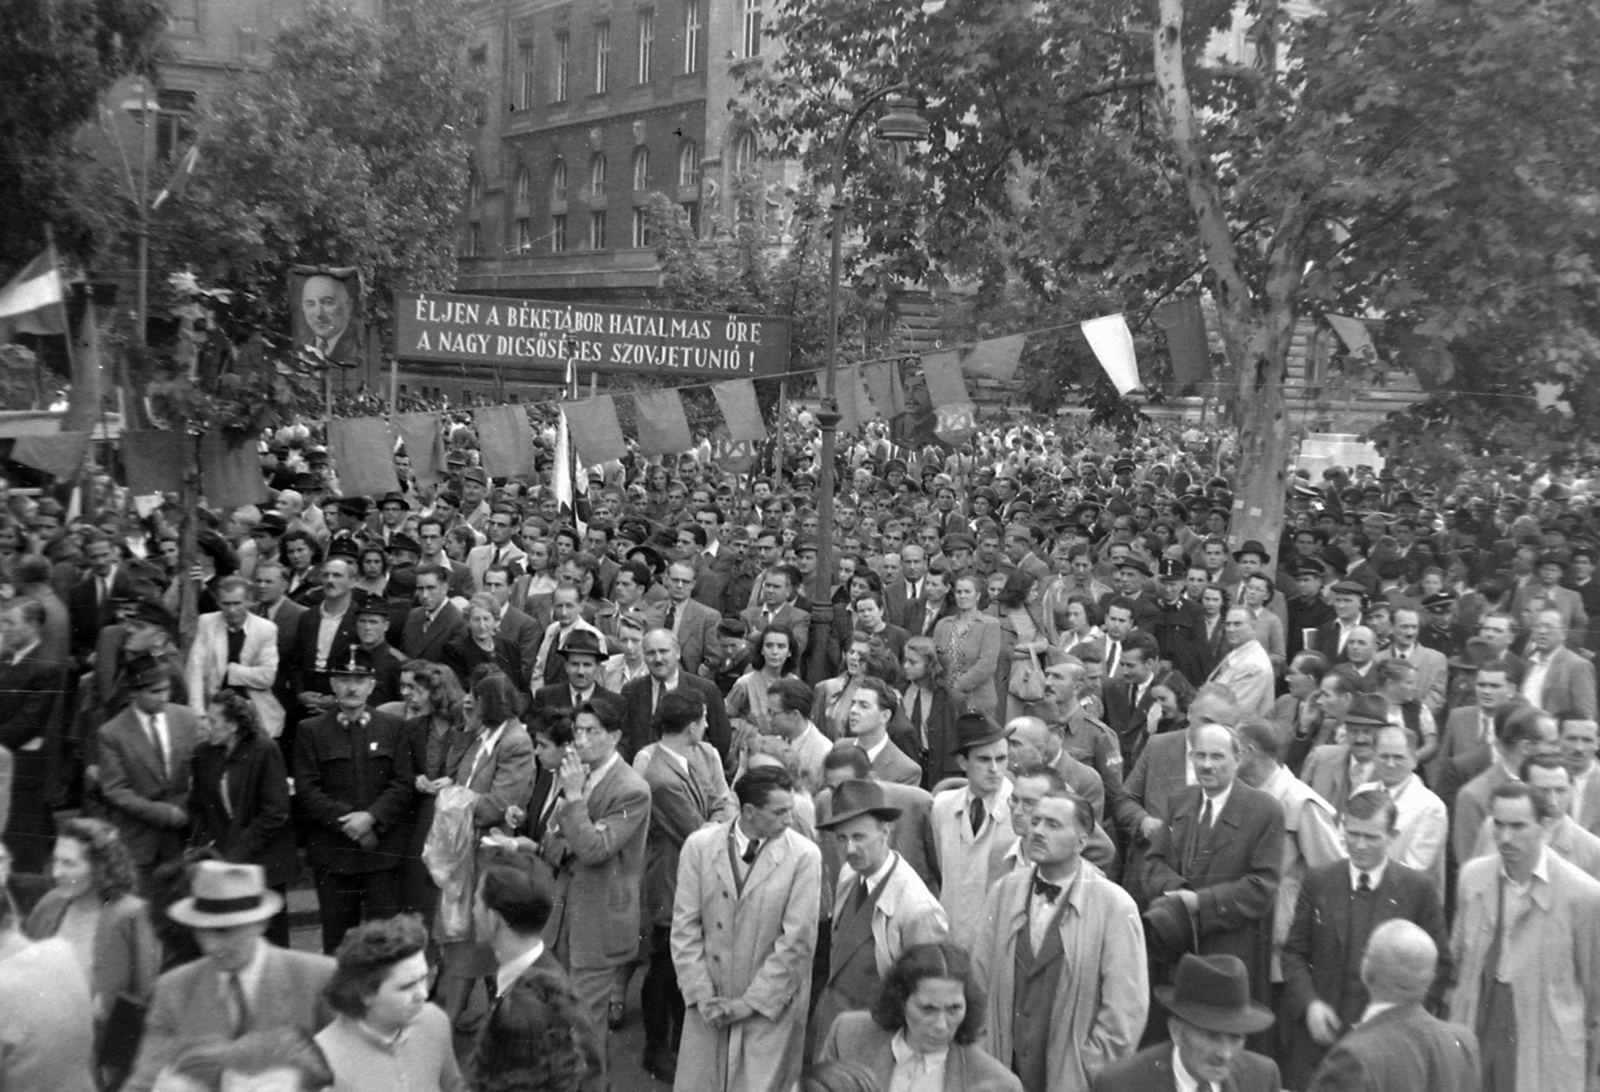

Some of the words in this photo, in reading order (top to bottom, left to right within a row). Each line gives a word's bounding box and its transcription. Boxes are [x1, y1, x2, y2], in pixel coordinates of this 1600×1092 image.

[416, 294, 480, 325] ÉLJEN
[486, 306, 500, 326] A
[506, 301, 604, 334] BÉKETÁBOR
[609, 313, 712, 340] HATALMAS
[725, 315, 762, 345] ŐRE
[416, 331, 432, 351] A
[438, 332, 491, 354] NAGY
[610, 342, 741, 370] SZOVJETUNIÓ
